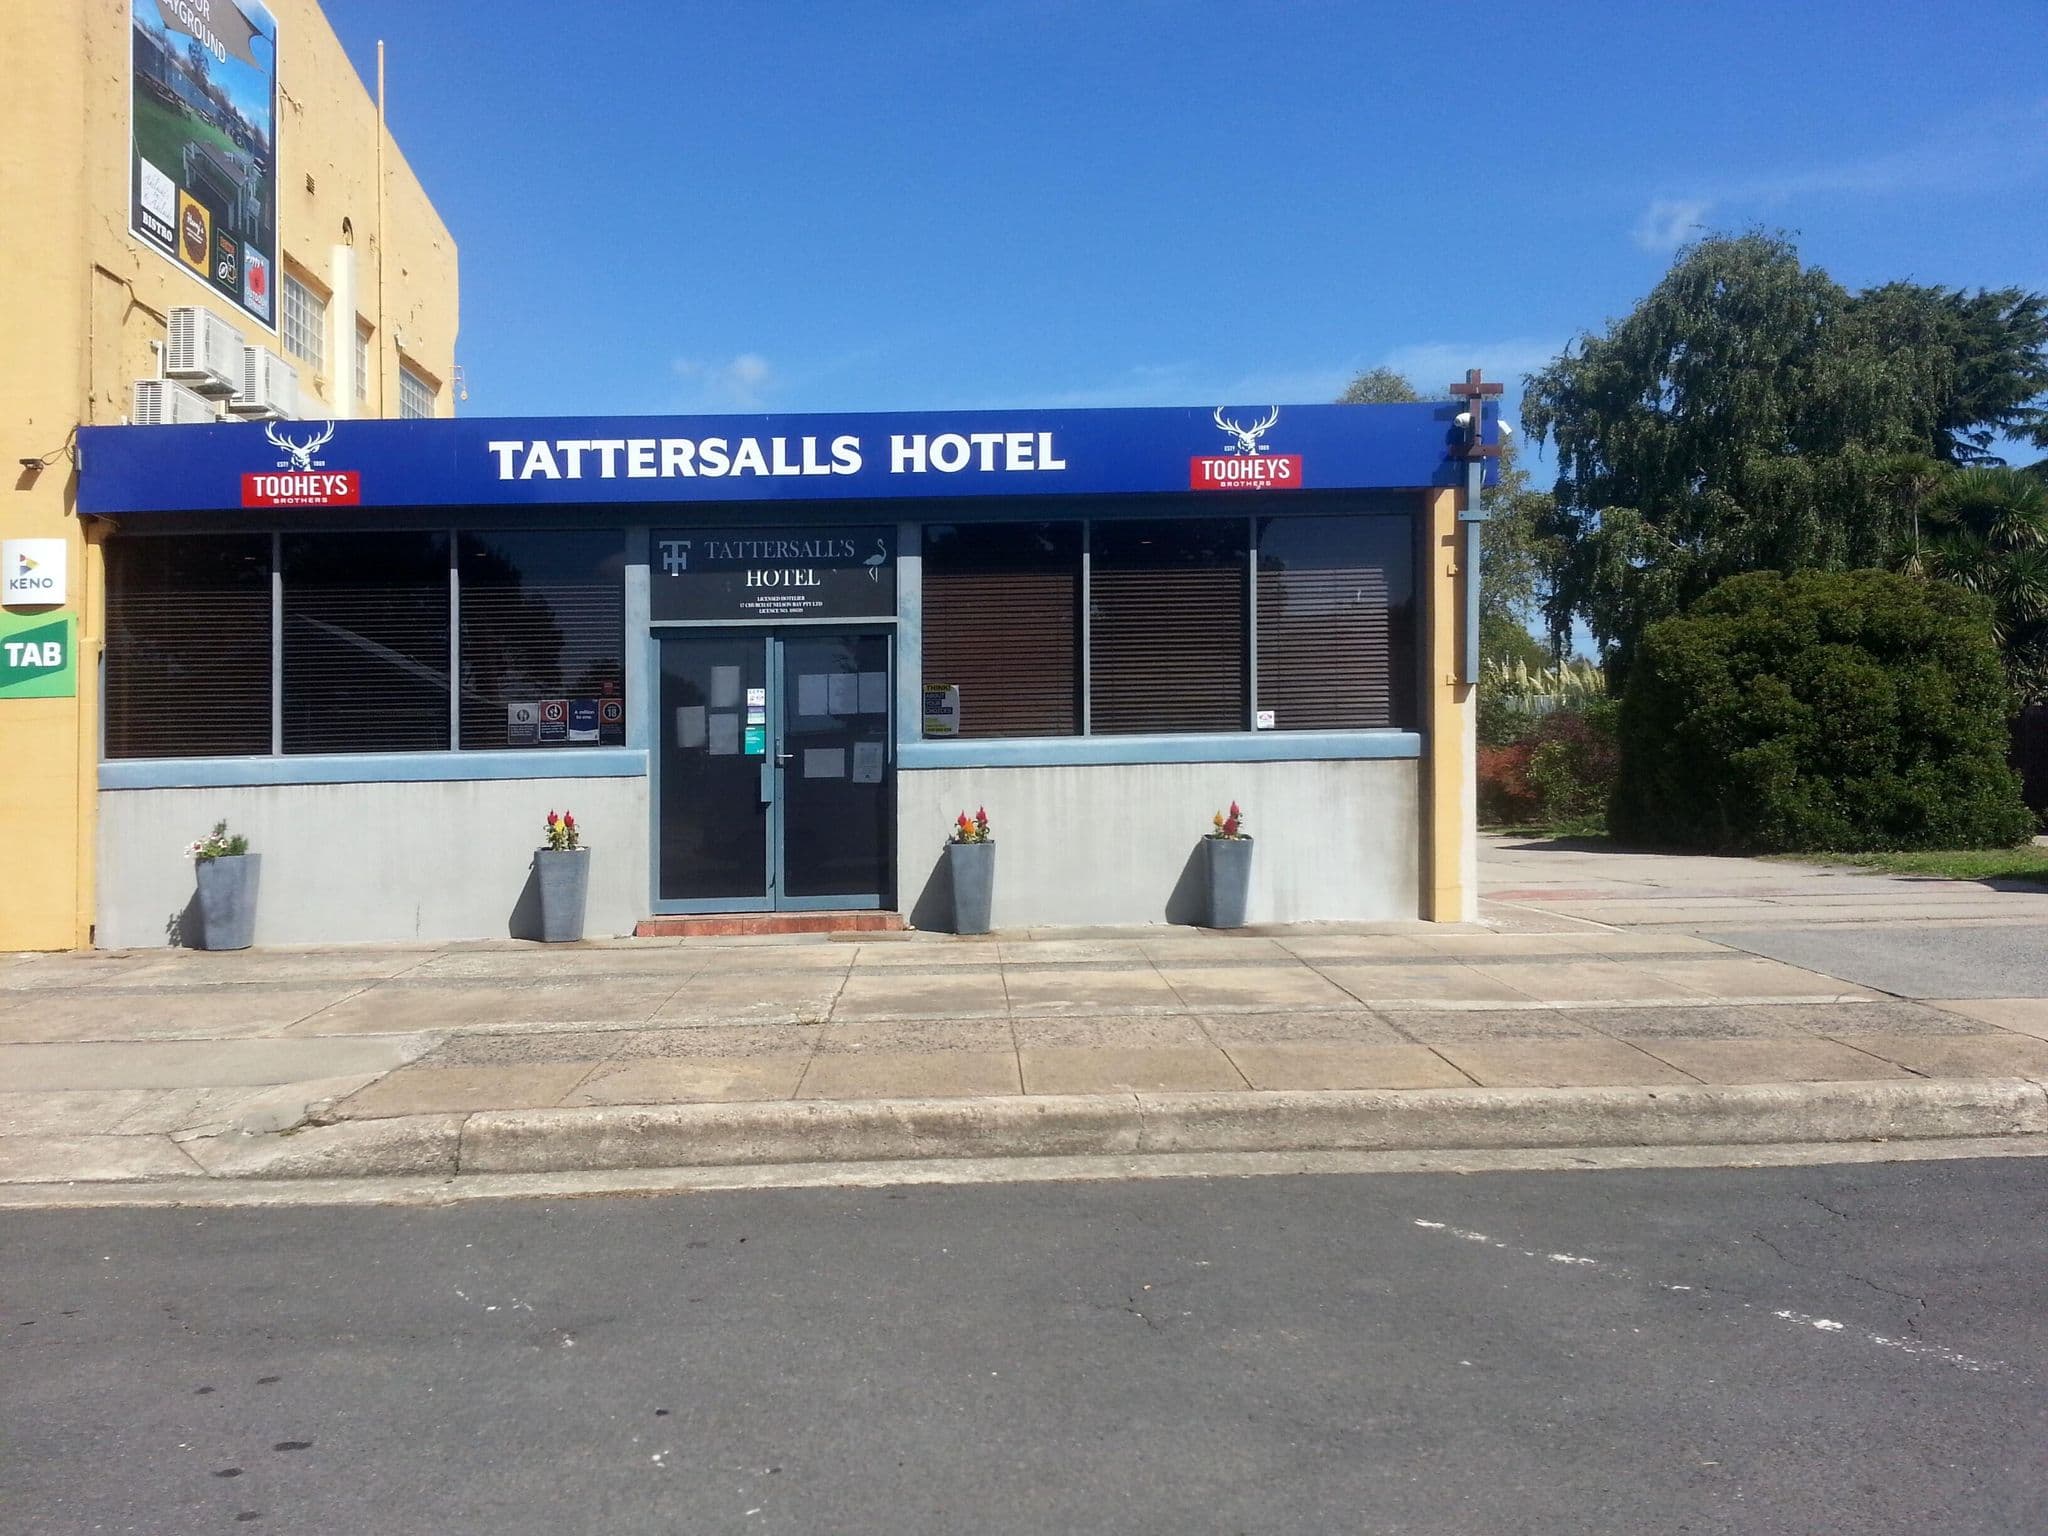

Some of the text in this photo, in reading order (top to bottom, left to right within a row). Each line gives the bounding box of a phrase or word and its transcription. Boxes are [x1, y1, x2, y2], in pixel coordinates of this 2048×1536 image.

[142, 211, 173, 242] BISTRO
[489, 432, 1065, 480] TATTERSALLS HOTEL
[1201, 458, 1290, 480] TOOHEYS
[253, 474, 348, 497] TOOHEYS
[704, 539, 855, 559] TATTERSALL'S
[9, 577, 53, 590] KENO
[746, 568, 821, 587] HOTEL
[4, 641, 61, 667] TAB
[607, 709, 617, 717] 18
